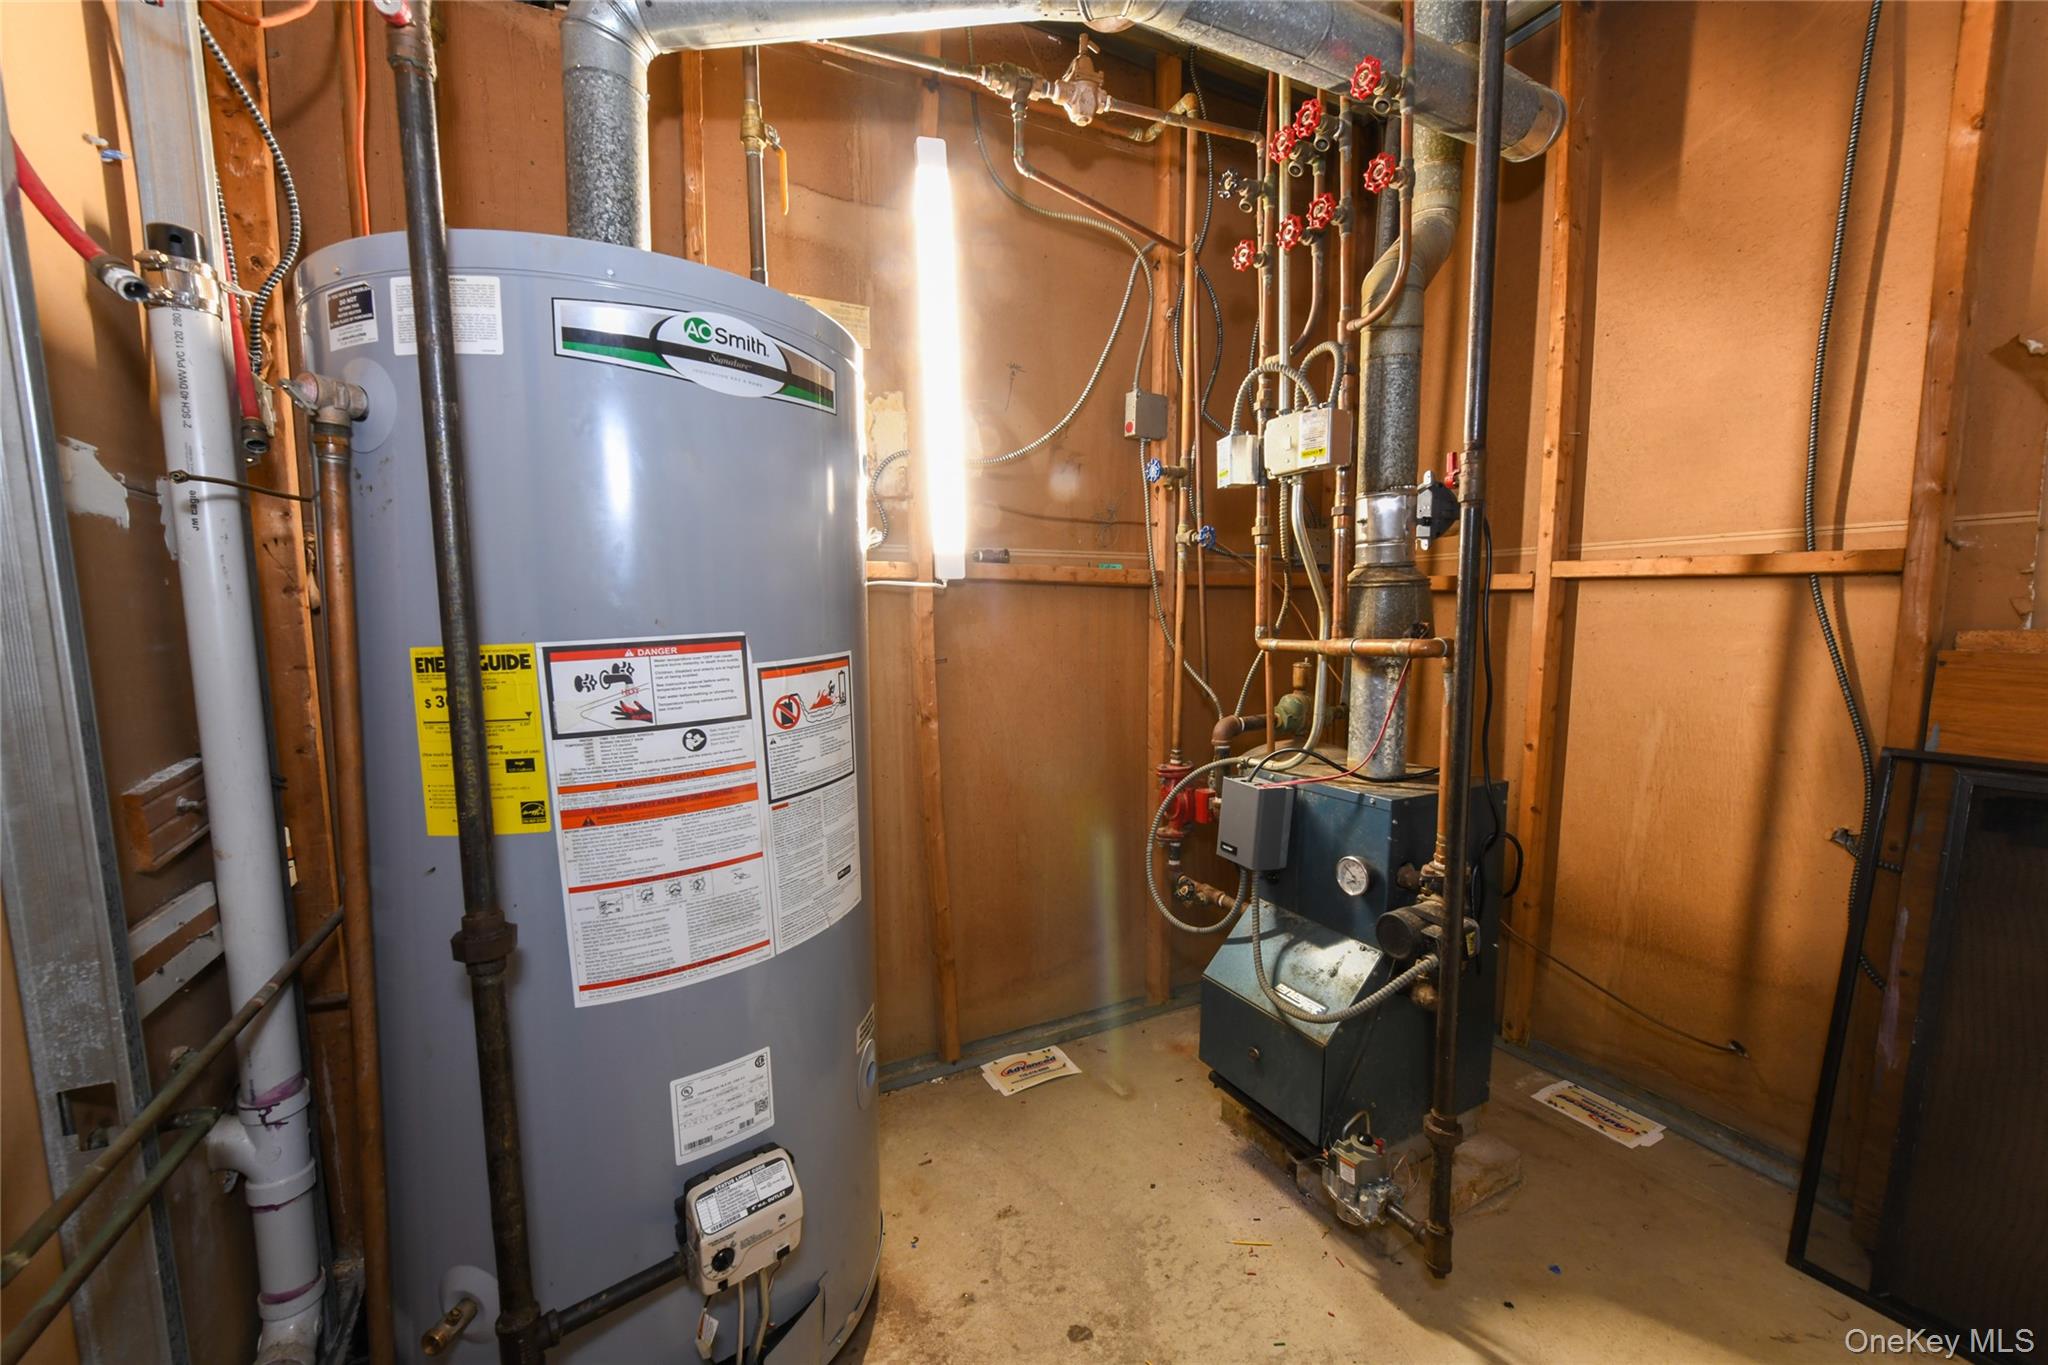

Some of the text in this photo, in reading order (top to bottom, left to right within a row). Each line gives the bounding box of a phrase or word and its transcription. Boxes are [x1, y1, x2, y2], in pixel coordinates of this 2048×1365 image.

[174, 330, 184, 349] 1120
[685, 318, 767, 357] AO Smith
[176, 351, 186, 369] PVC
[708, 352, 751, 370] Signature
[180, 390, 189, 400] 40
[181, 401, 192, 419] SCH
[192, 518, 200, 532] JM
[637, 647, 678, 657] DANGER
[1006, 1055, 1056, 1075] Advanced
[768, 1190, 786, 1203] OUTLET
